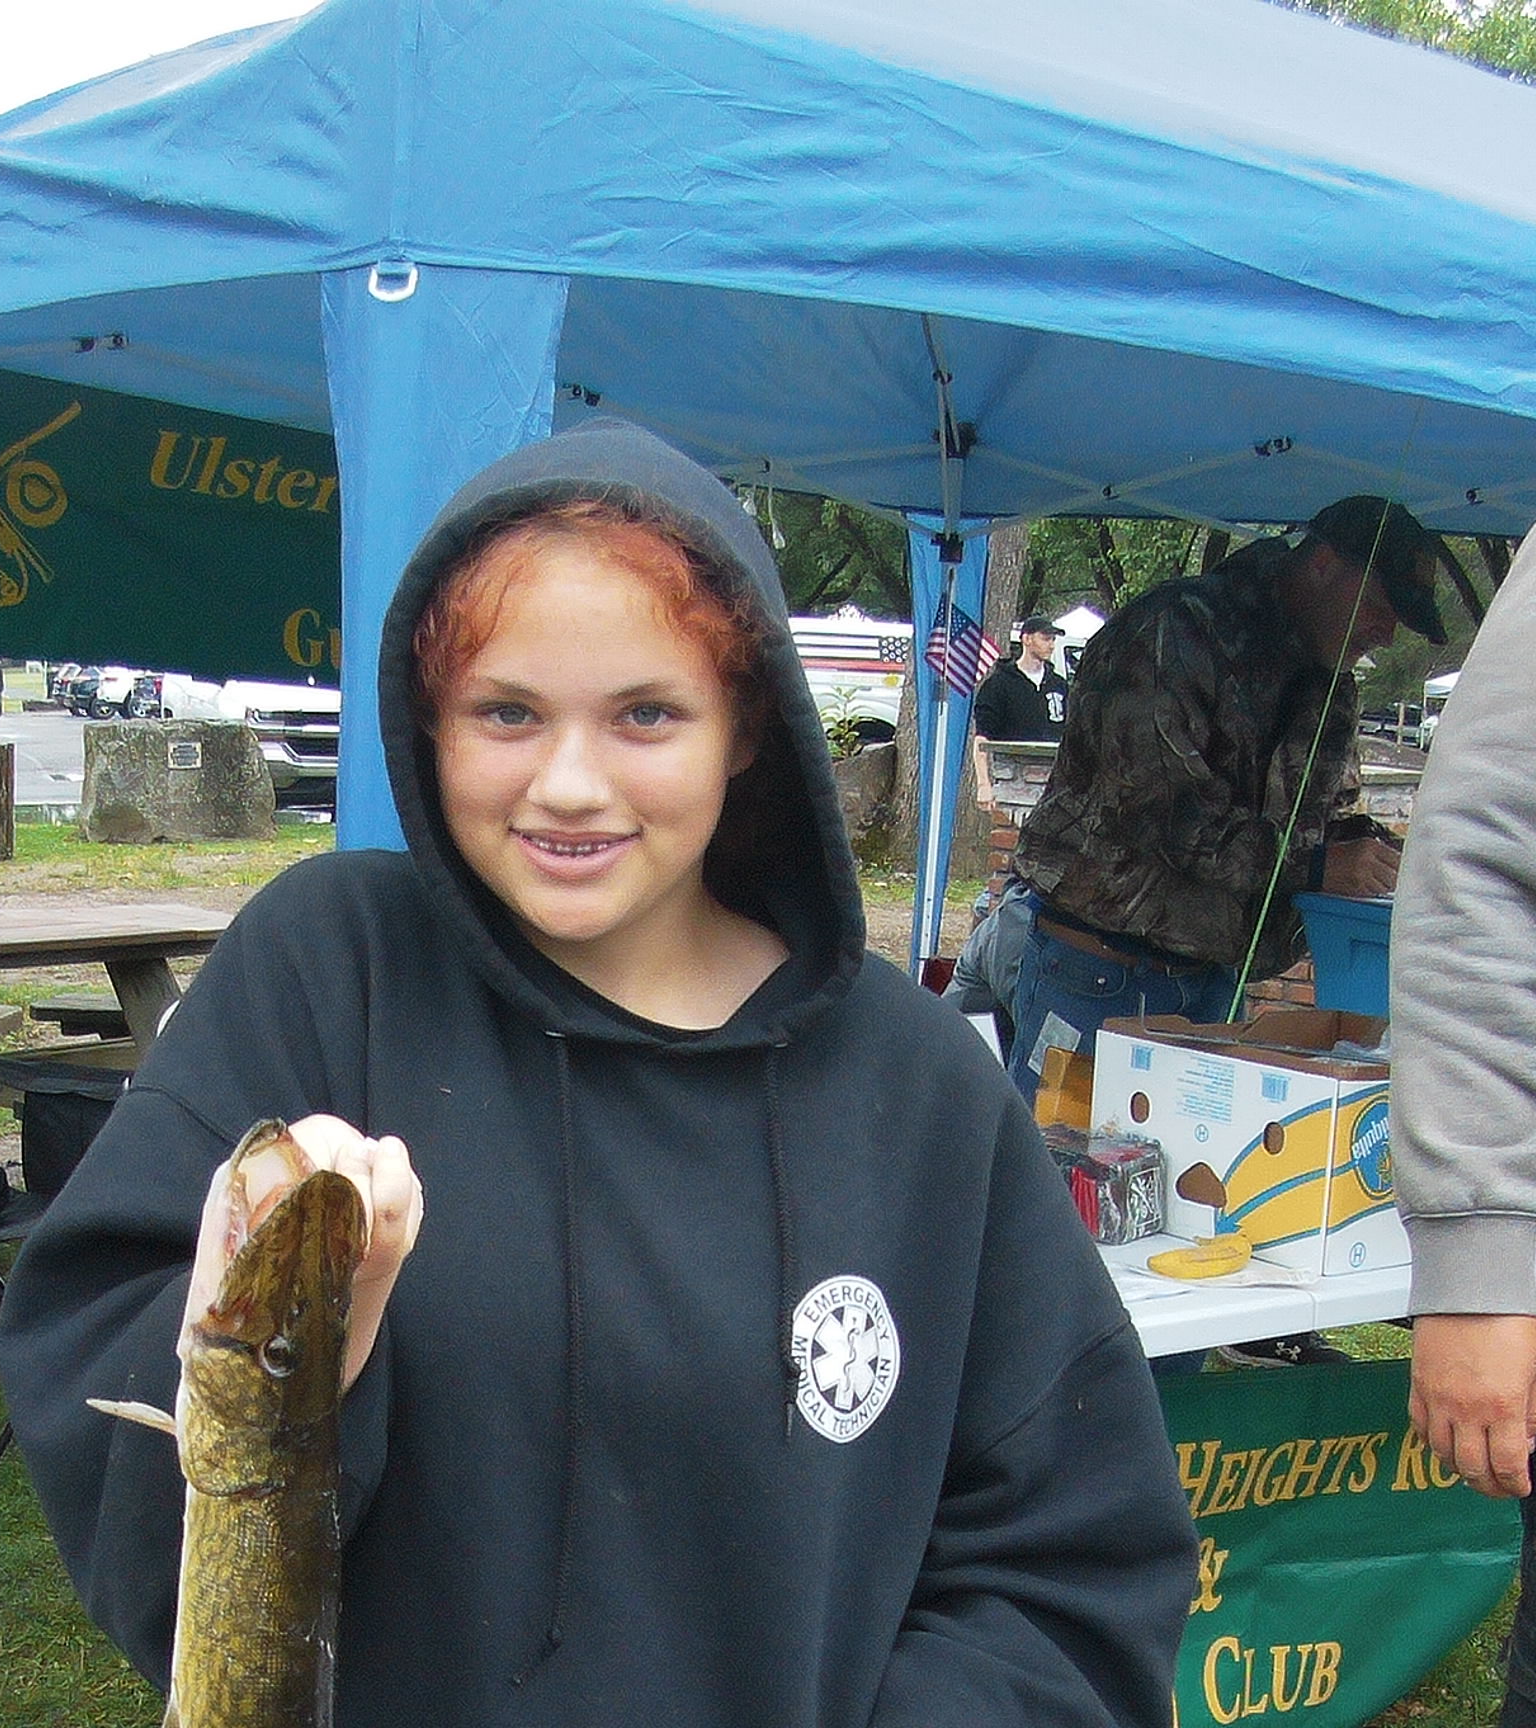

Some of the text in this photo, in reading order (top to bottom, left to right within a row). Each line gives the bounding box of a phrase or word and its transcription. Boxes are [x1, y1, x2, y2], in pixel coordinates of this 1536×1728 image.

[150, 429, 336, 513] Ulster
[1351, 1117, 1390, 1160] iquita
[803, 1285, 890, 1341] EMERGENCY
[792, 1335, 826, 1426] MEDICAL
[832, 1358, 892, 1435] TECHNICIAN
[1175, 1432, 1389, 1520] HEIGHTS
[1202, 1635, 1343, 1725] CLUB
